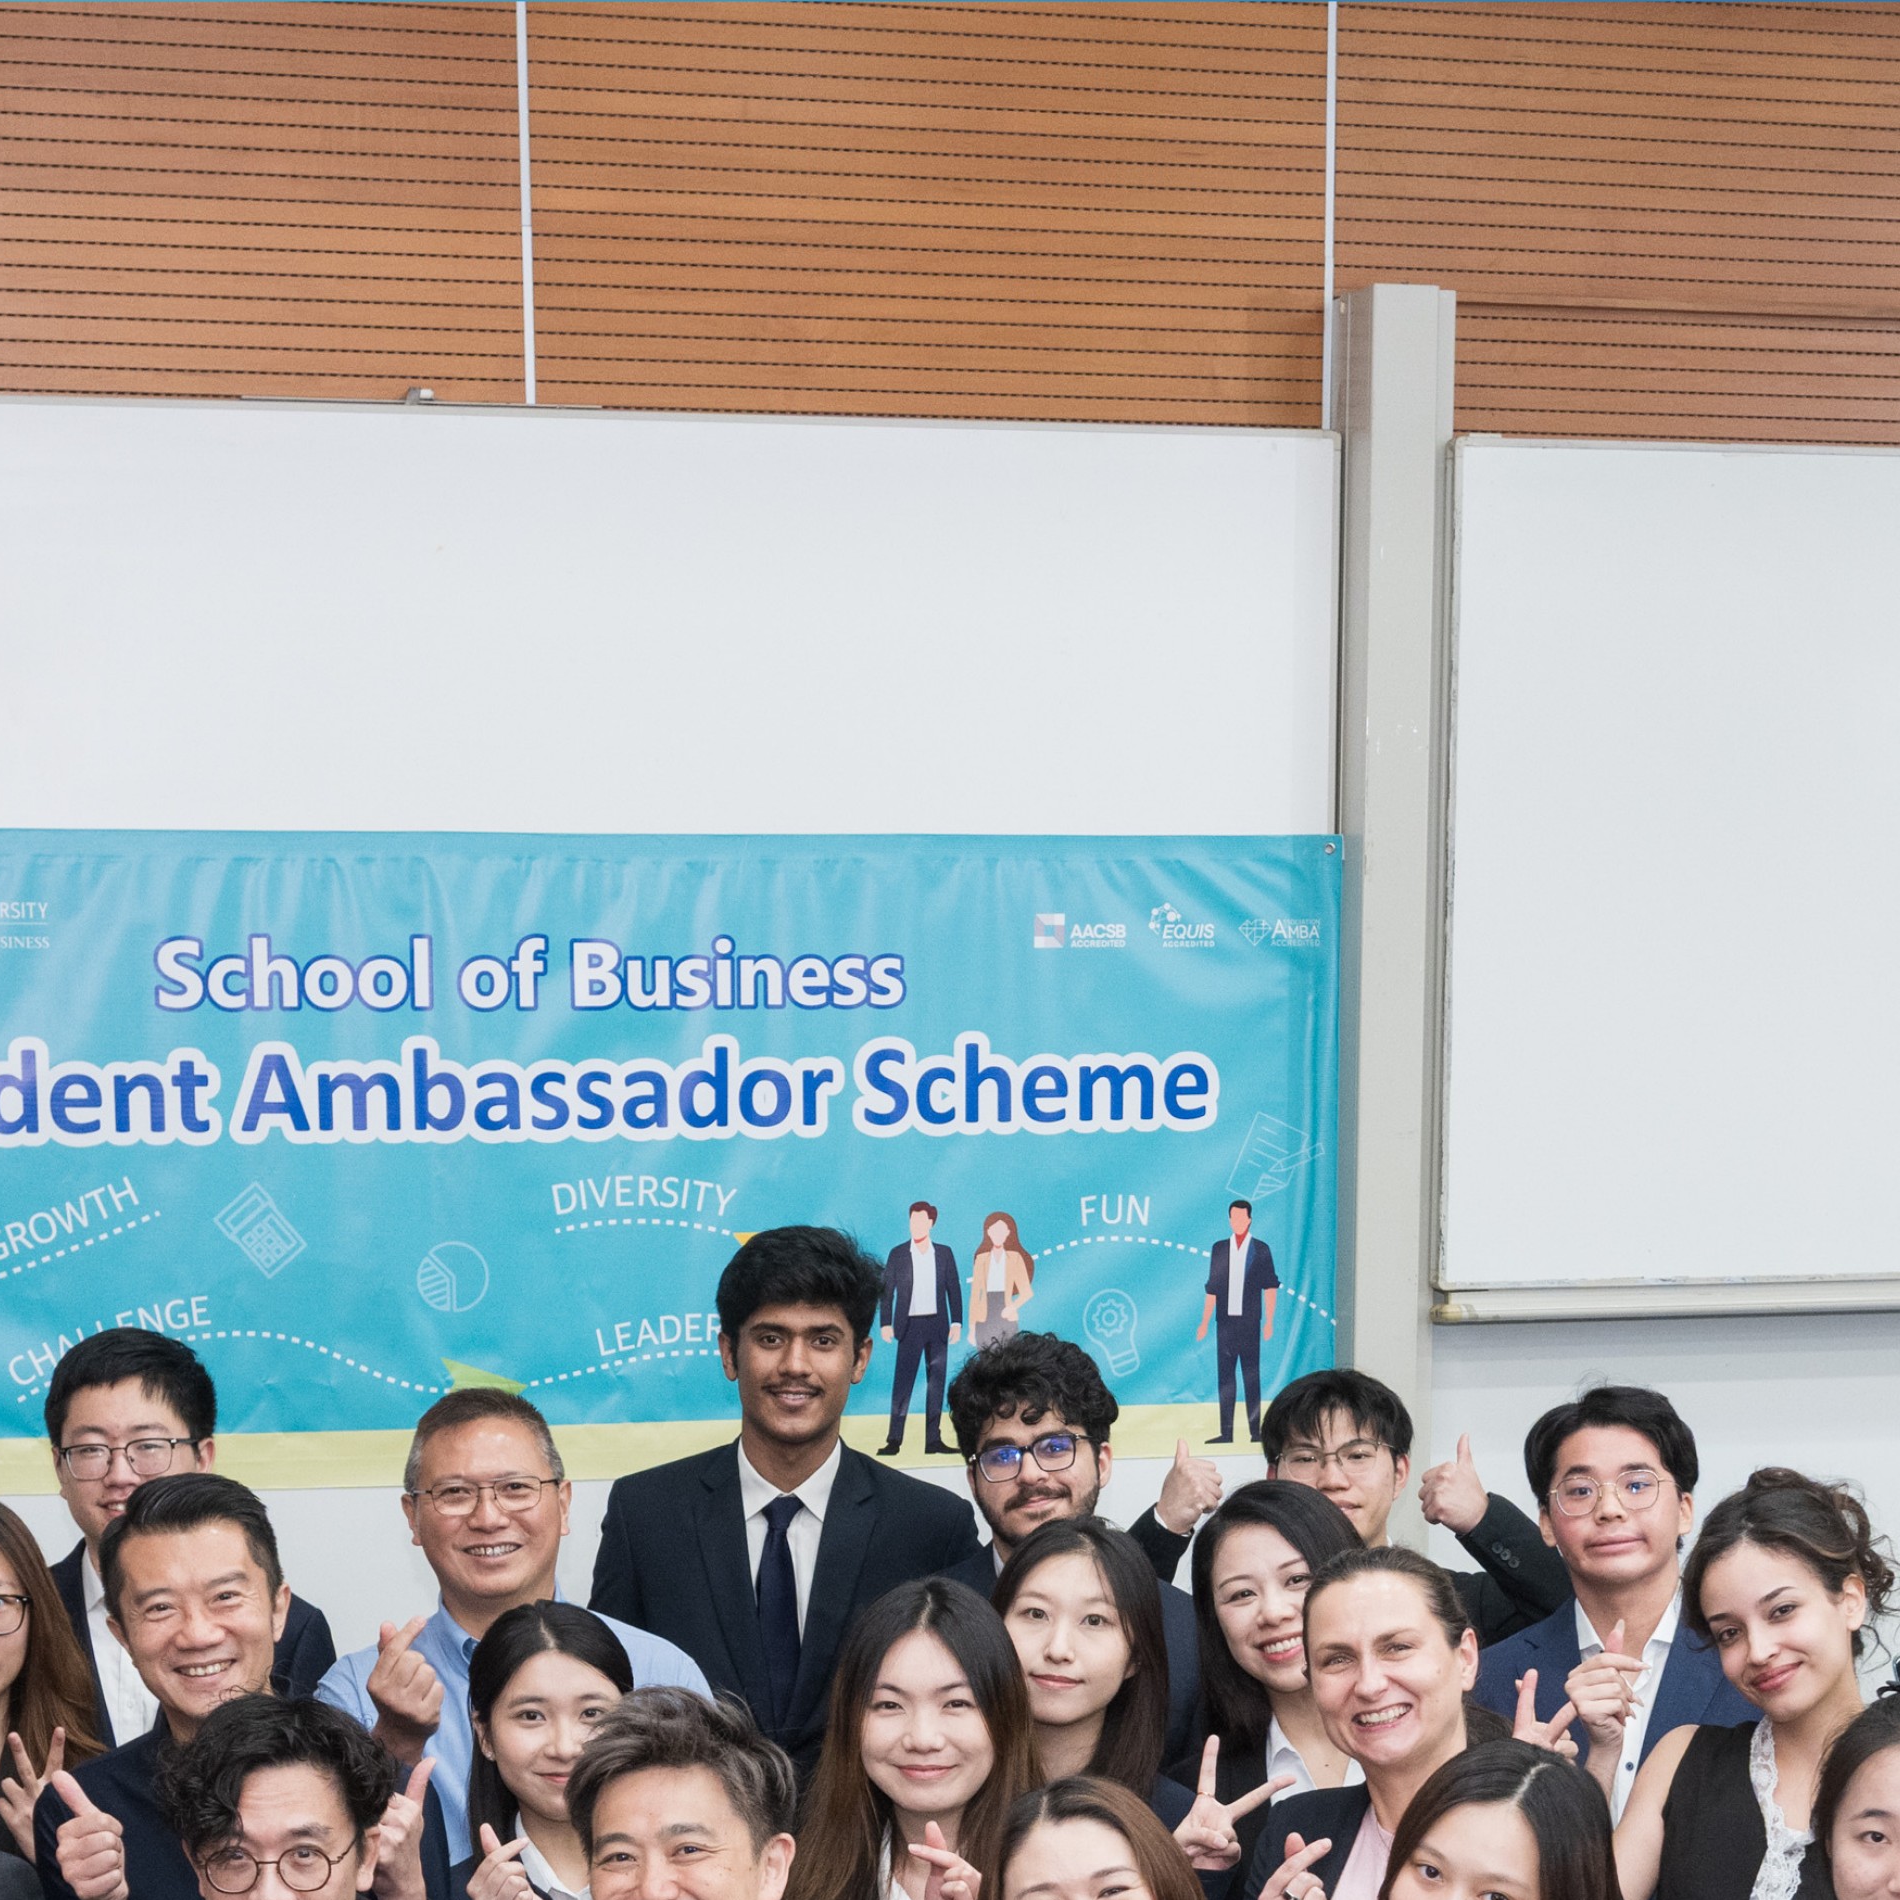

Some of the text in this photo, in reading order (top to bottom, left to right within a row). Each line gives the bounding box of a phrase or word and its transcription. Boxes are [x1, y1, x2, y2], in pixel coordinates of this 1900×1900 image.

[1070, 923, 1127, 939] AACSB
[1162, 923, 1215, 940] EQUIS
[1270, 918, 1320, 939] AMBA
[1070, 939, 1127, 949] ACCREDITED
[1162, 940, 1216, 948] ACCREDITED
[1270, 939, 1321, 947] ACCREDITED
[155, 934, 906, 1011] School of Business
[239, 1035, 836, 1134] Ambassador
[862, 1040, 1210, 1126] Scheme
[551, 1175, 738, 1217] DIVERSITY
[1080, 1193, 1151, 1227] FUN
